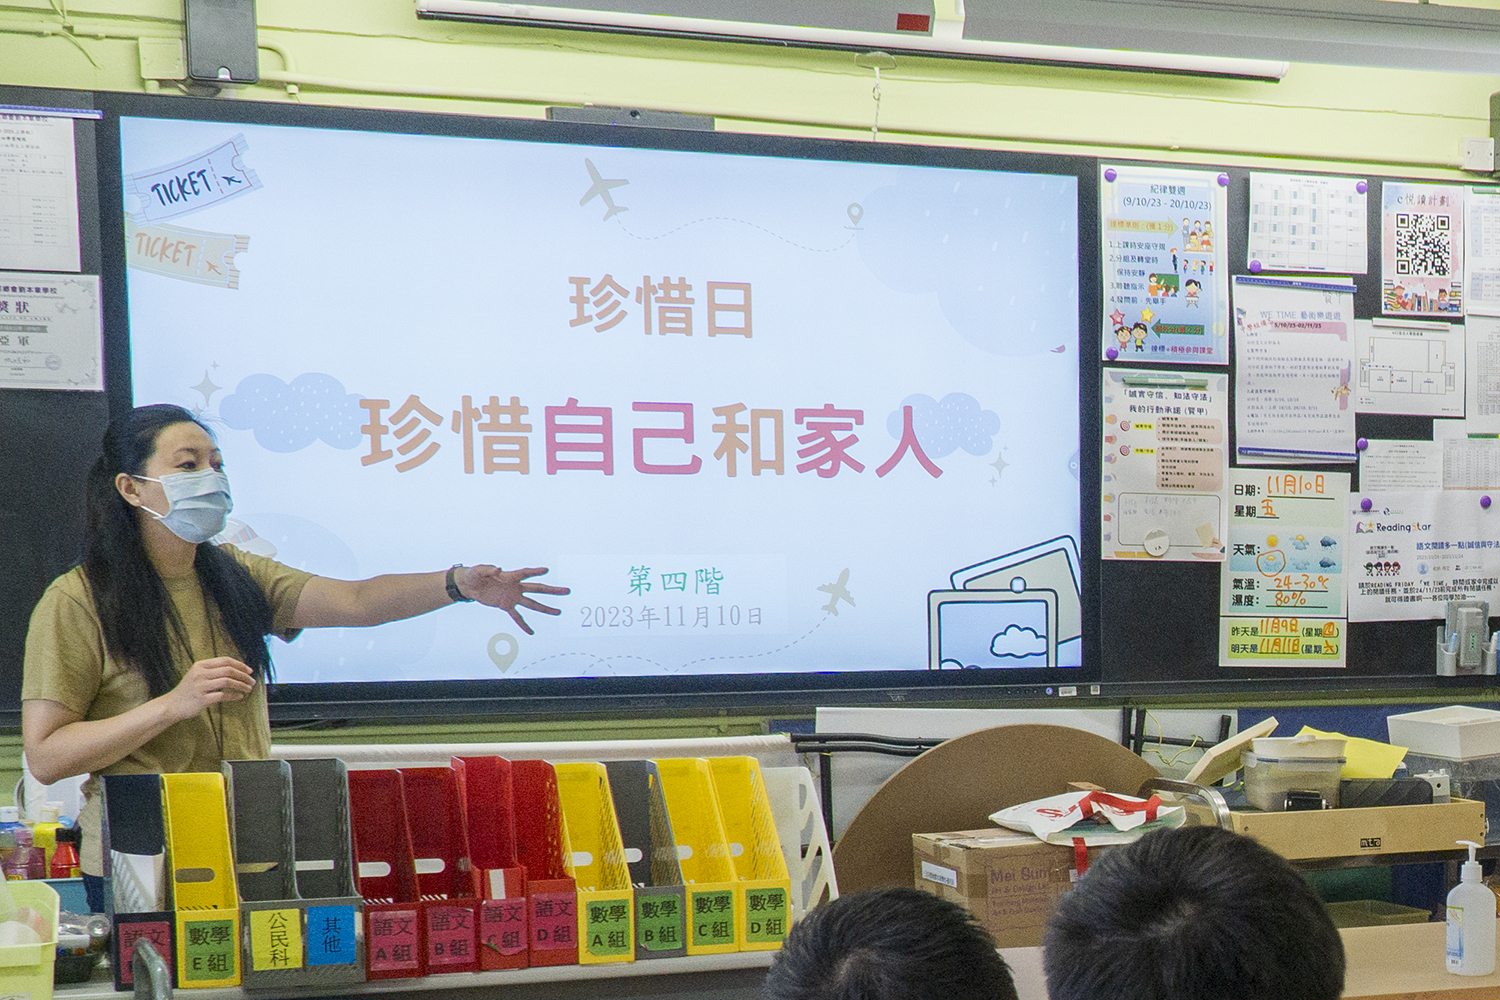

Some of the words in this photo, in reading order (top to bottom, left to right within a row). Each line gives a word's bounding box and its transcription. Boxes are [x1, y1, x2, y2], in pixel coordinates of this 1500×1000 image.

[151, 169, 213, 206] TICKET
[1123, 196, 1162, 208] (9/10/23
[1170, 199, 1212, 211] 20/10/23)
[134, 232, 197, 267] TICKET
[568, 273, 753, 338] 珍惜日
[359, 394, 943, 479] 珍惜自己和家人
[1234, 484, 1261, 497] 日期：
[1267, 474, 1325, 495] 11月10日
[1234, 505, 1256, 518] 星期
[1262, 499, 1276, 517] 五
[1233, 544, 1261, 556] 天氣：
[626, 564, 725, 596] 第四階
[1274, 591, 1306, 607] 80%
[580, 604, 763, 629] 2023年11月10日
[535, 899, 573, 918] 語文
[641, 900, 678, 919] 數學
[695, 895, 731, 915] 數學
[749, 893, 784, 911] 數學
[430, 912, 471, 932] 語文
[483, 905, 522, 923] 語文
[590, 905, 627, 924] 數學
[189, 926, 232, 946] 數學
[322, 917, 342, 954] 其他
[374, 918, 414, 937] 語文
[537, 928, 548, 942] D
[553, 924, 573, 943] 組
[644, 930, 653, 943] B
[658, 926, 678, 945] 組
[698, 924, 708, 937] C
[712, 921, 730, 939] 組
[751, 922, 761, 935] D
[766, 918, 784, 936] 組
[123, 929, 166, 948] 語文
[269, 912, 290, 967] 公民科
[487, 934, 498, 947] C
[502, 930, 521, 949] 組
[591, 934, 603, 947] A
[607, 930, 627, 949] 組
[375, 948, 388, 961] A
[393, 943, 413, 962] 組
[435, 942, 445, 956] B
[449, 939, 469, 958] 組
[192, 958, 201, 971] E
[207, 952, 229, 972] 組
